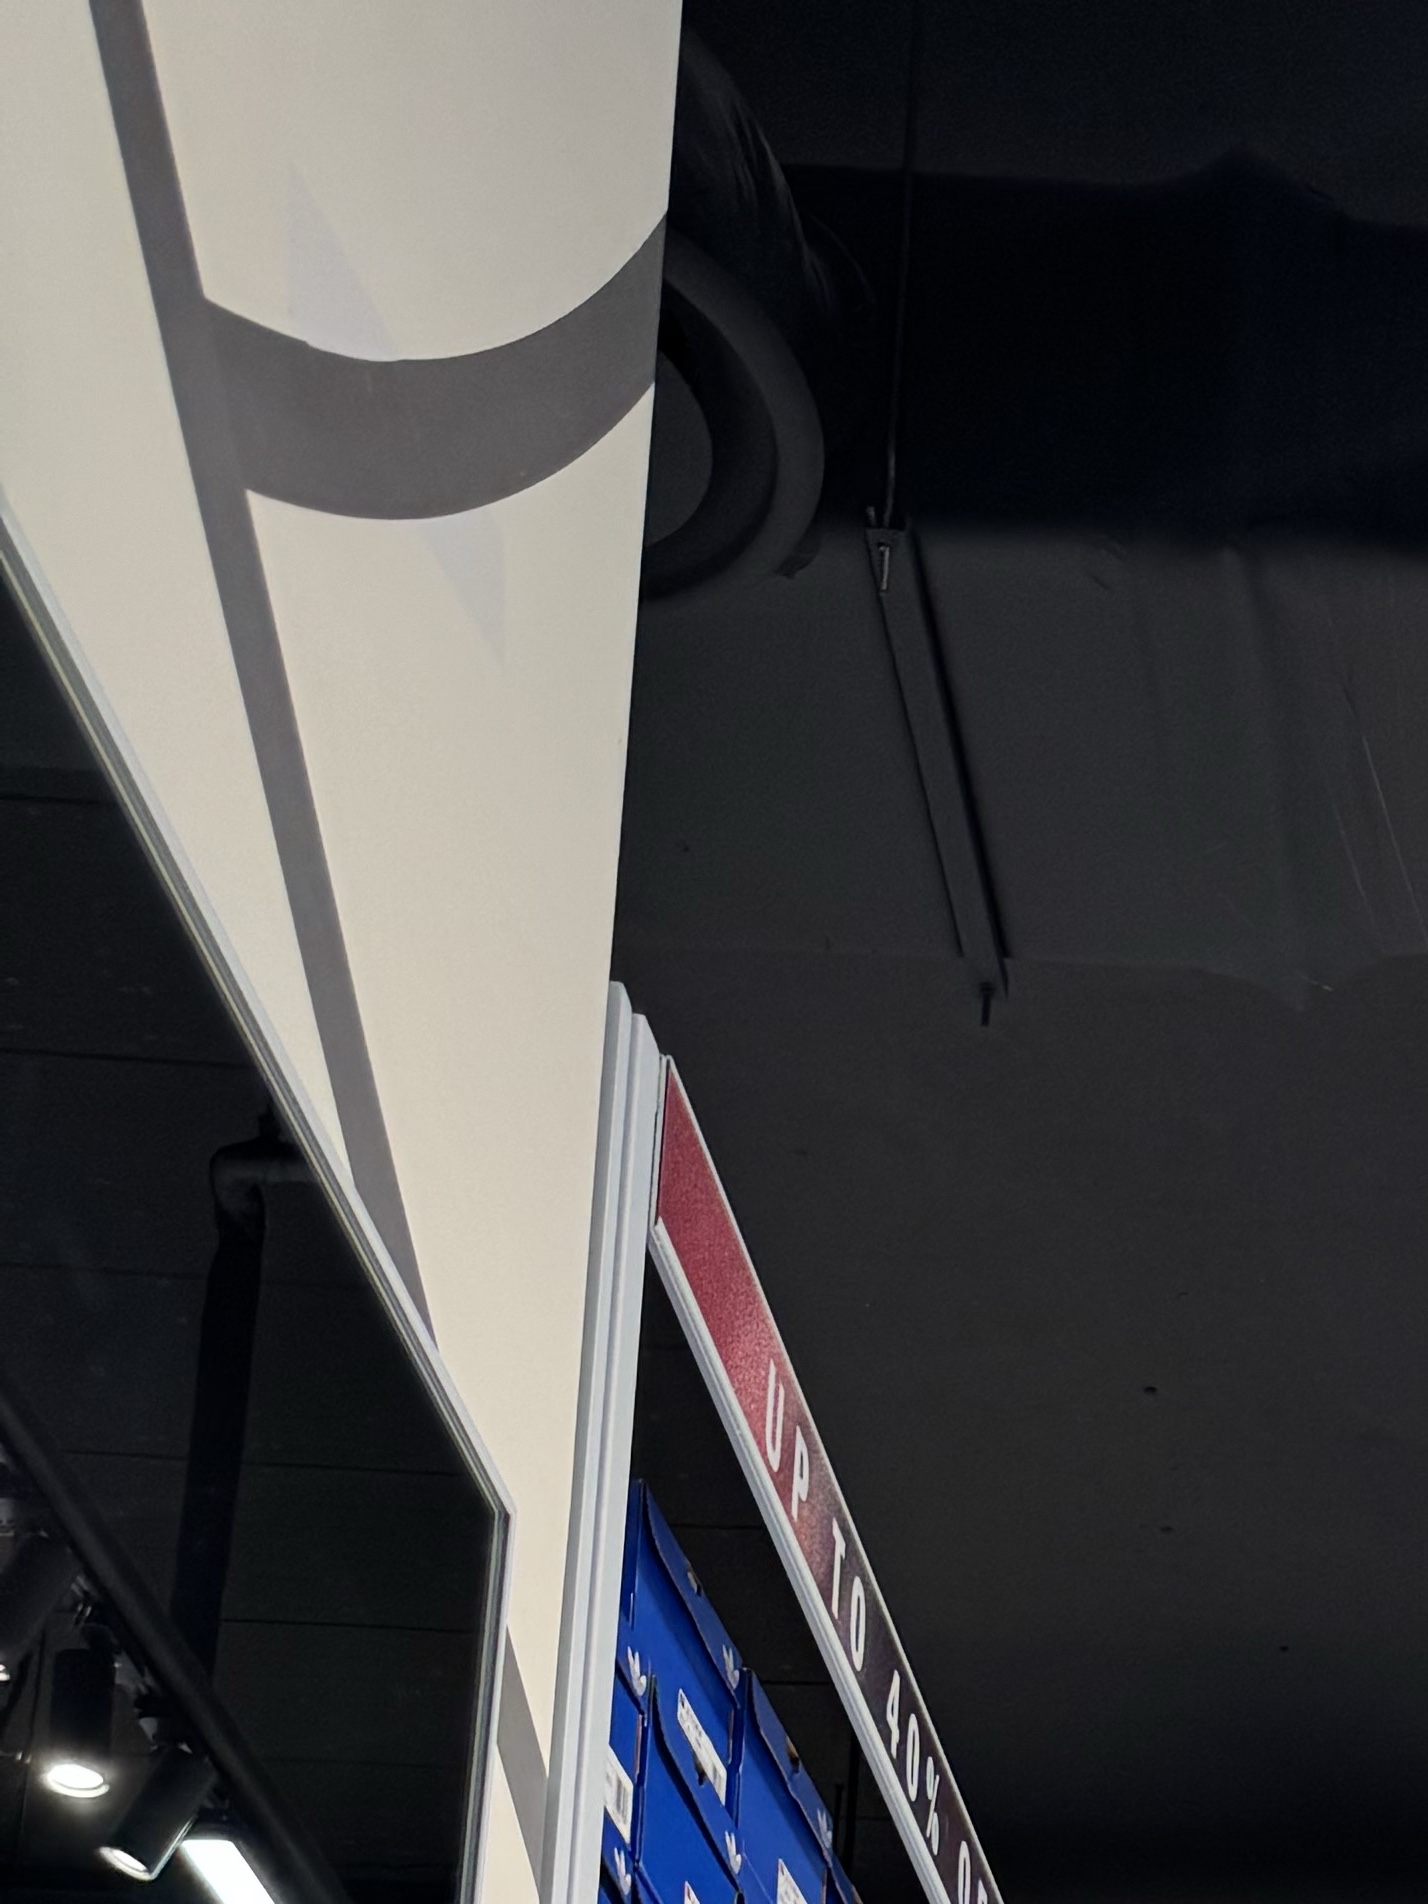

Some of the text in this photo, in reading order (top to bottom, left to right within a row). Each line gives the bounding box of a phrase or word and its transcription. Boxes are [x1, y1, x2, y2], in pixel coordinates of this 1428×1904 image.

[765, 1358, 809, 1522] UP
[832, 1517, 867, 1672] TO
[887, 1669, 940, 1856] 40%
